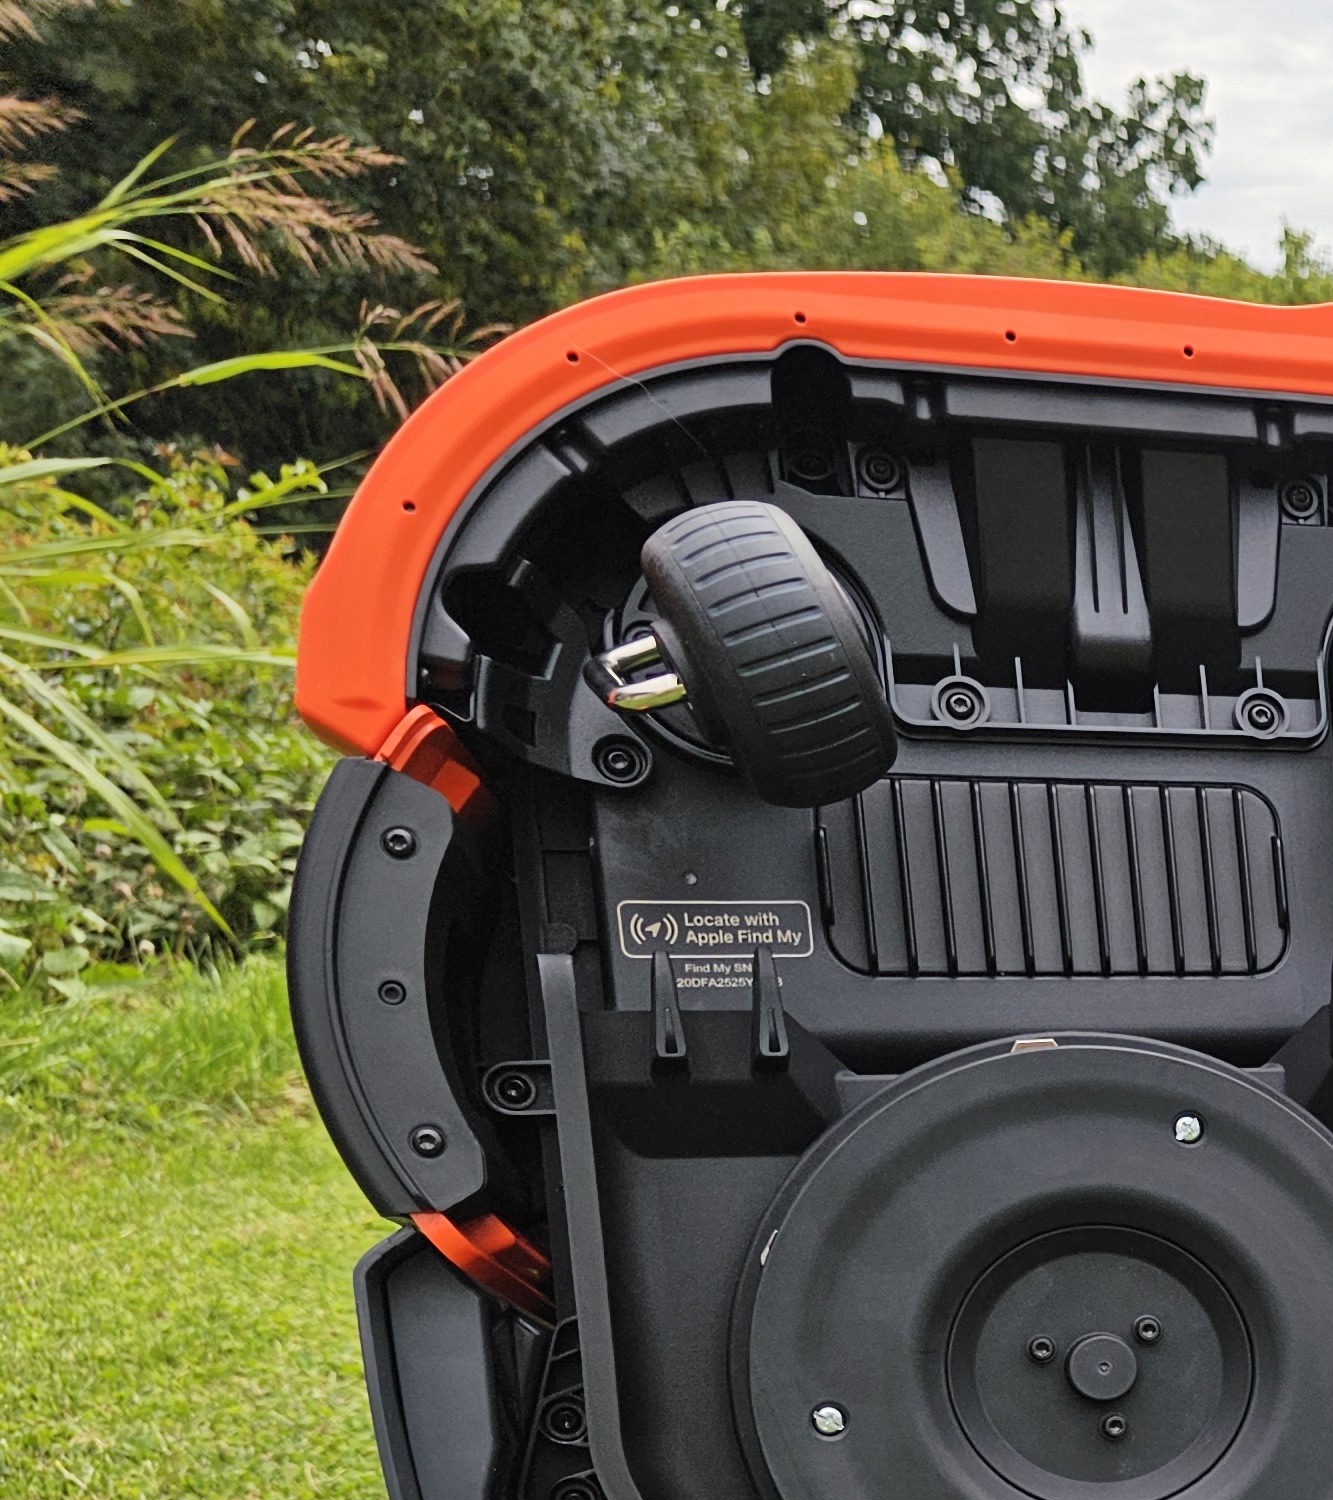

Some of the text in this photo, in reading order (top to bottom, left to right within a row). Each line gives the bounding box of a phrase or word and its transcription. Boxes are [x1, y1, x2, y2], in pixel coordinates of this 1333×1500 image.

[684, 912, 779, 927] Locate with
[685, 929, 802, 946] Apple Find My
[685, 963, 710, 973] Find
[713, 963, 731, 975] My
